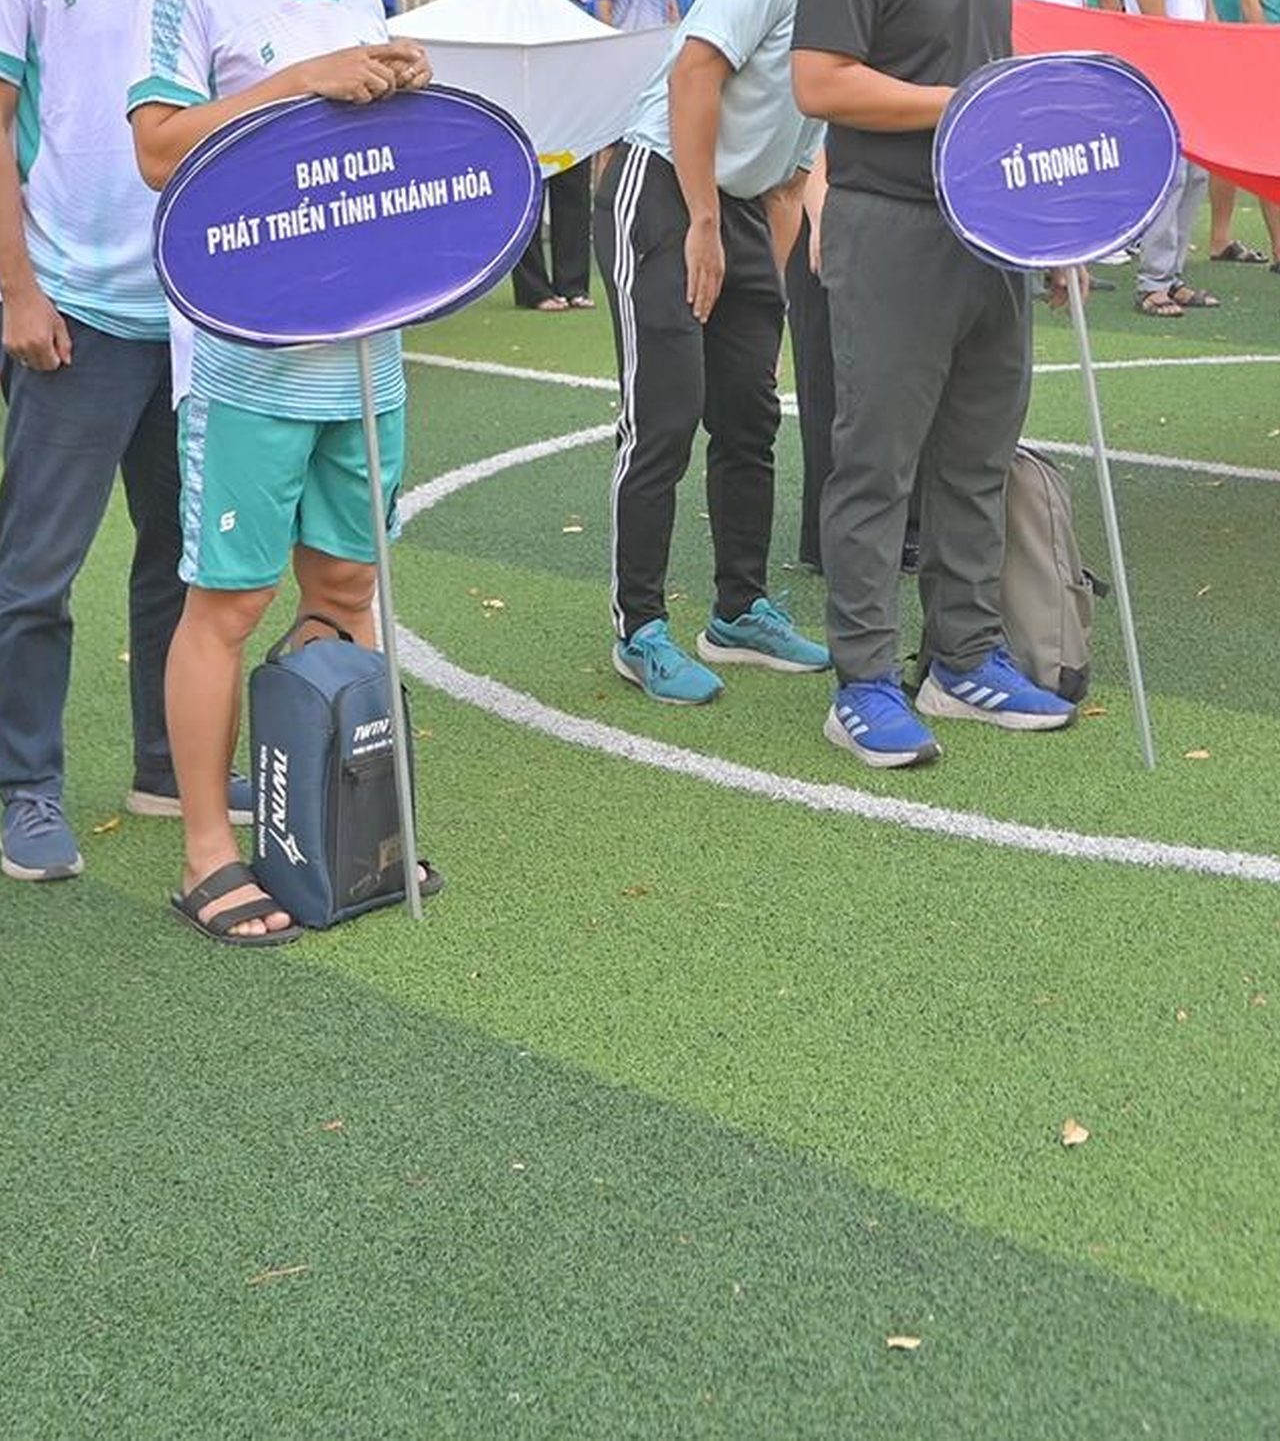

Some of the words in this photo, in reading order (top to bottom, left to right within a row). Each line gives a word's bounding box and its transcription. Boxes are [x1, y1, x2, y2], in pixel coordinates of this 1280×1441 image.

[296, 157, 340, 190] BAN
[343, 147, 395, 181] QLDA
[1000, 143, 1027, 190] TỔ
[1027, 143, 1089, 187] TRỌNG
[1088, 132, 1120, 172] TÀI
[207, 215, 261, 255] PHÁT
[265, 196, 326, 241] TRIỂN
[329, 190, 377, 227] TỈNH
[380, 178, 449, 217] KHÁNH
[451, 167, 493, 202] HÒA
